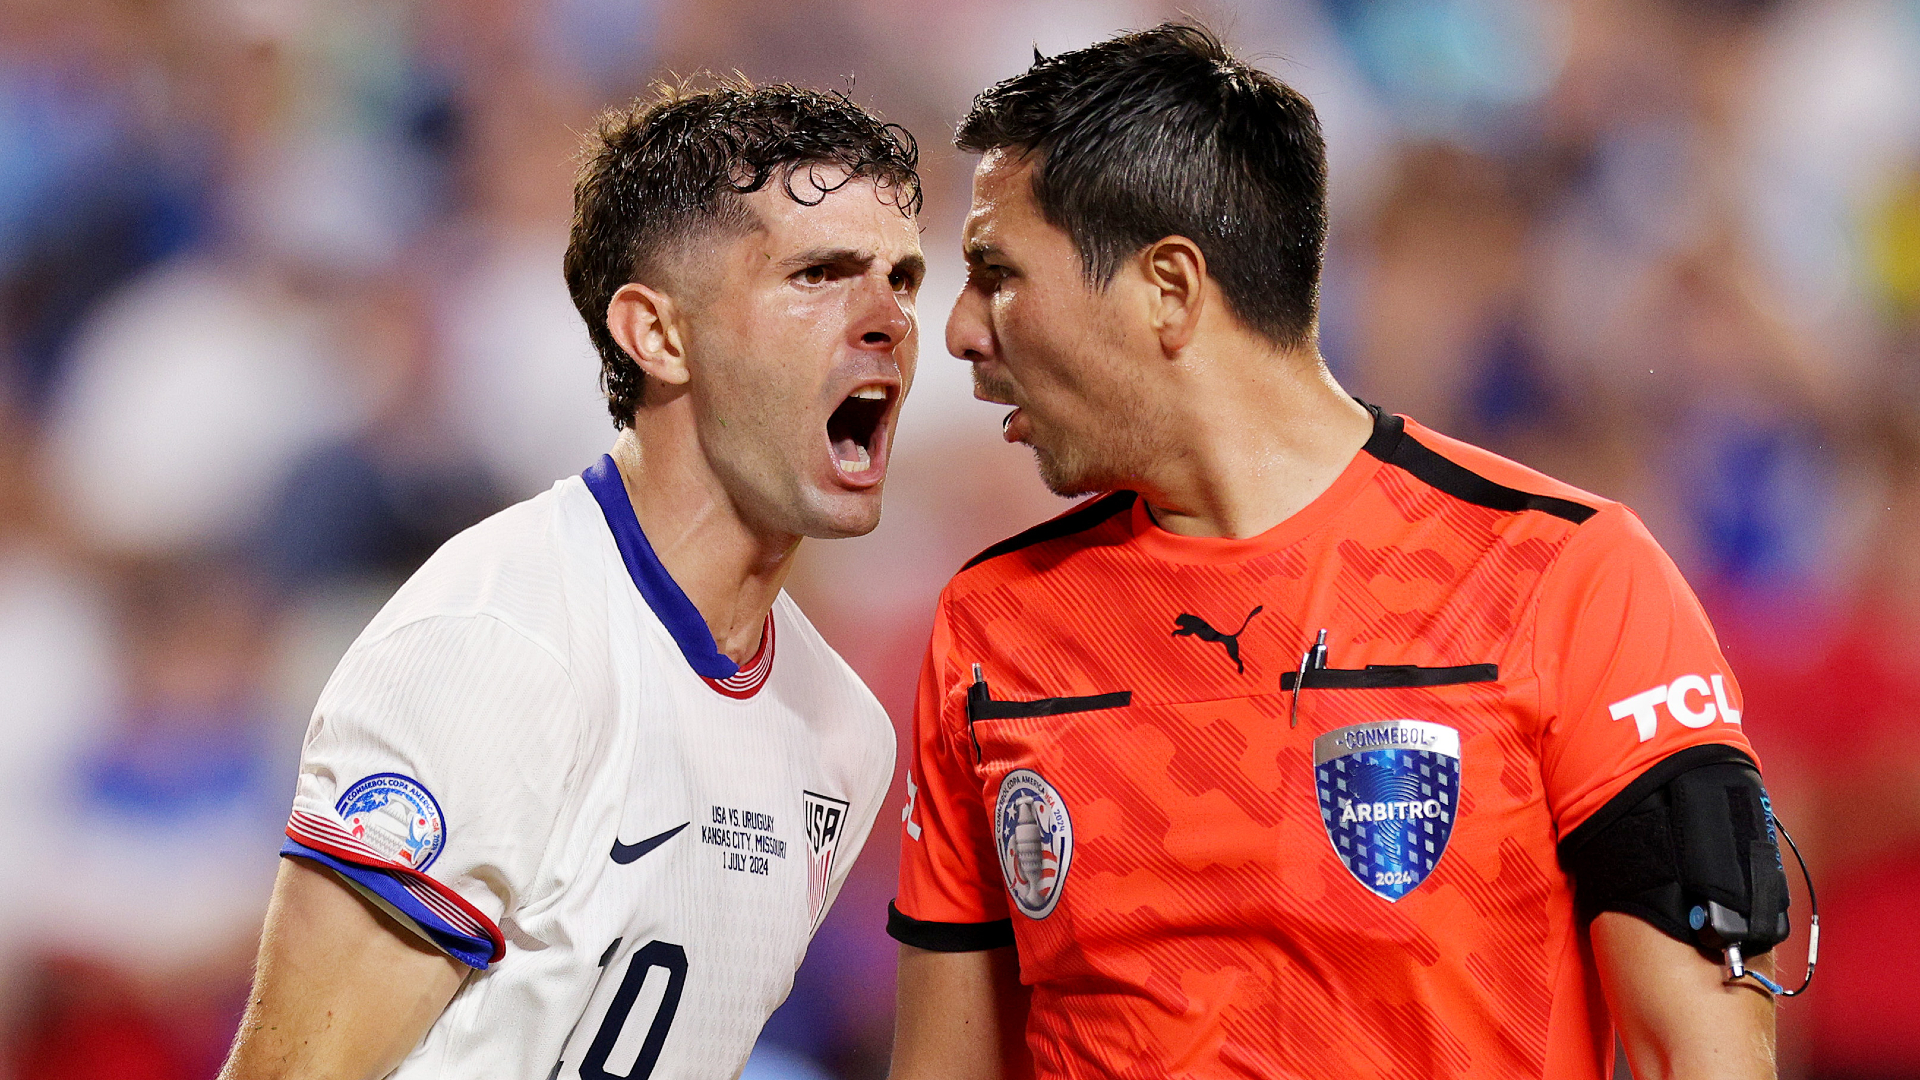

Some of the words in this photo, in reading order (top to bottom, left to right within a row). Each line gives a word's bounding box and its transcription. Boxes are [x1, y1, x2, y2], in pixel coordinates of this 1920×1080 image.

[1608, 674, 1741, 743] TCL
[347, 779, 387, 801] CONMEBOL
[388, 779, 408, 790] COPA
[996, 787, 1009, 833] CONMEBOL
[1006, 776, 1021, 790] COPA
[1044, 791, 1056, 809] USA
[1053, 808, 1066, 832] 2024
[712, 805, 727, 825] USA
[728, 808, 741, 828] VS.
[742, 810, 775, 834] URUGUAY
[1341, 799, 1442, 823] ÁRBITRO
[805, 800, 841, 855] USA
[701, 825, 731, 848] KANSAS
[732, 830, 754, 853] CITY,
[755, 834, 787, 860] MISSOURI
[722, 851, 726, 869] 1
[727, 852, 747, 872] JULY
[749, 855, 769, 876] 2024
[1375, 870, 1412, 886] 2024
